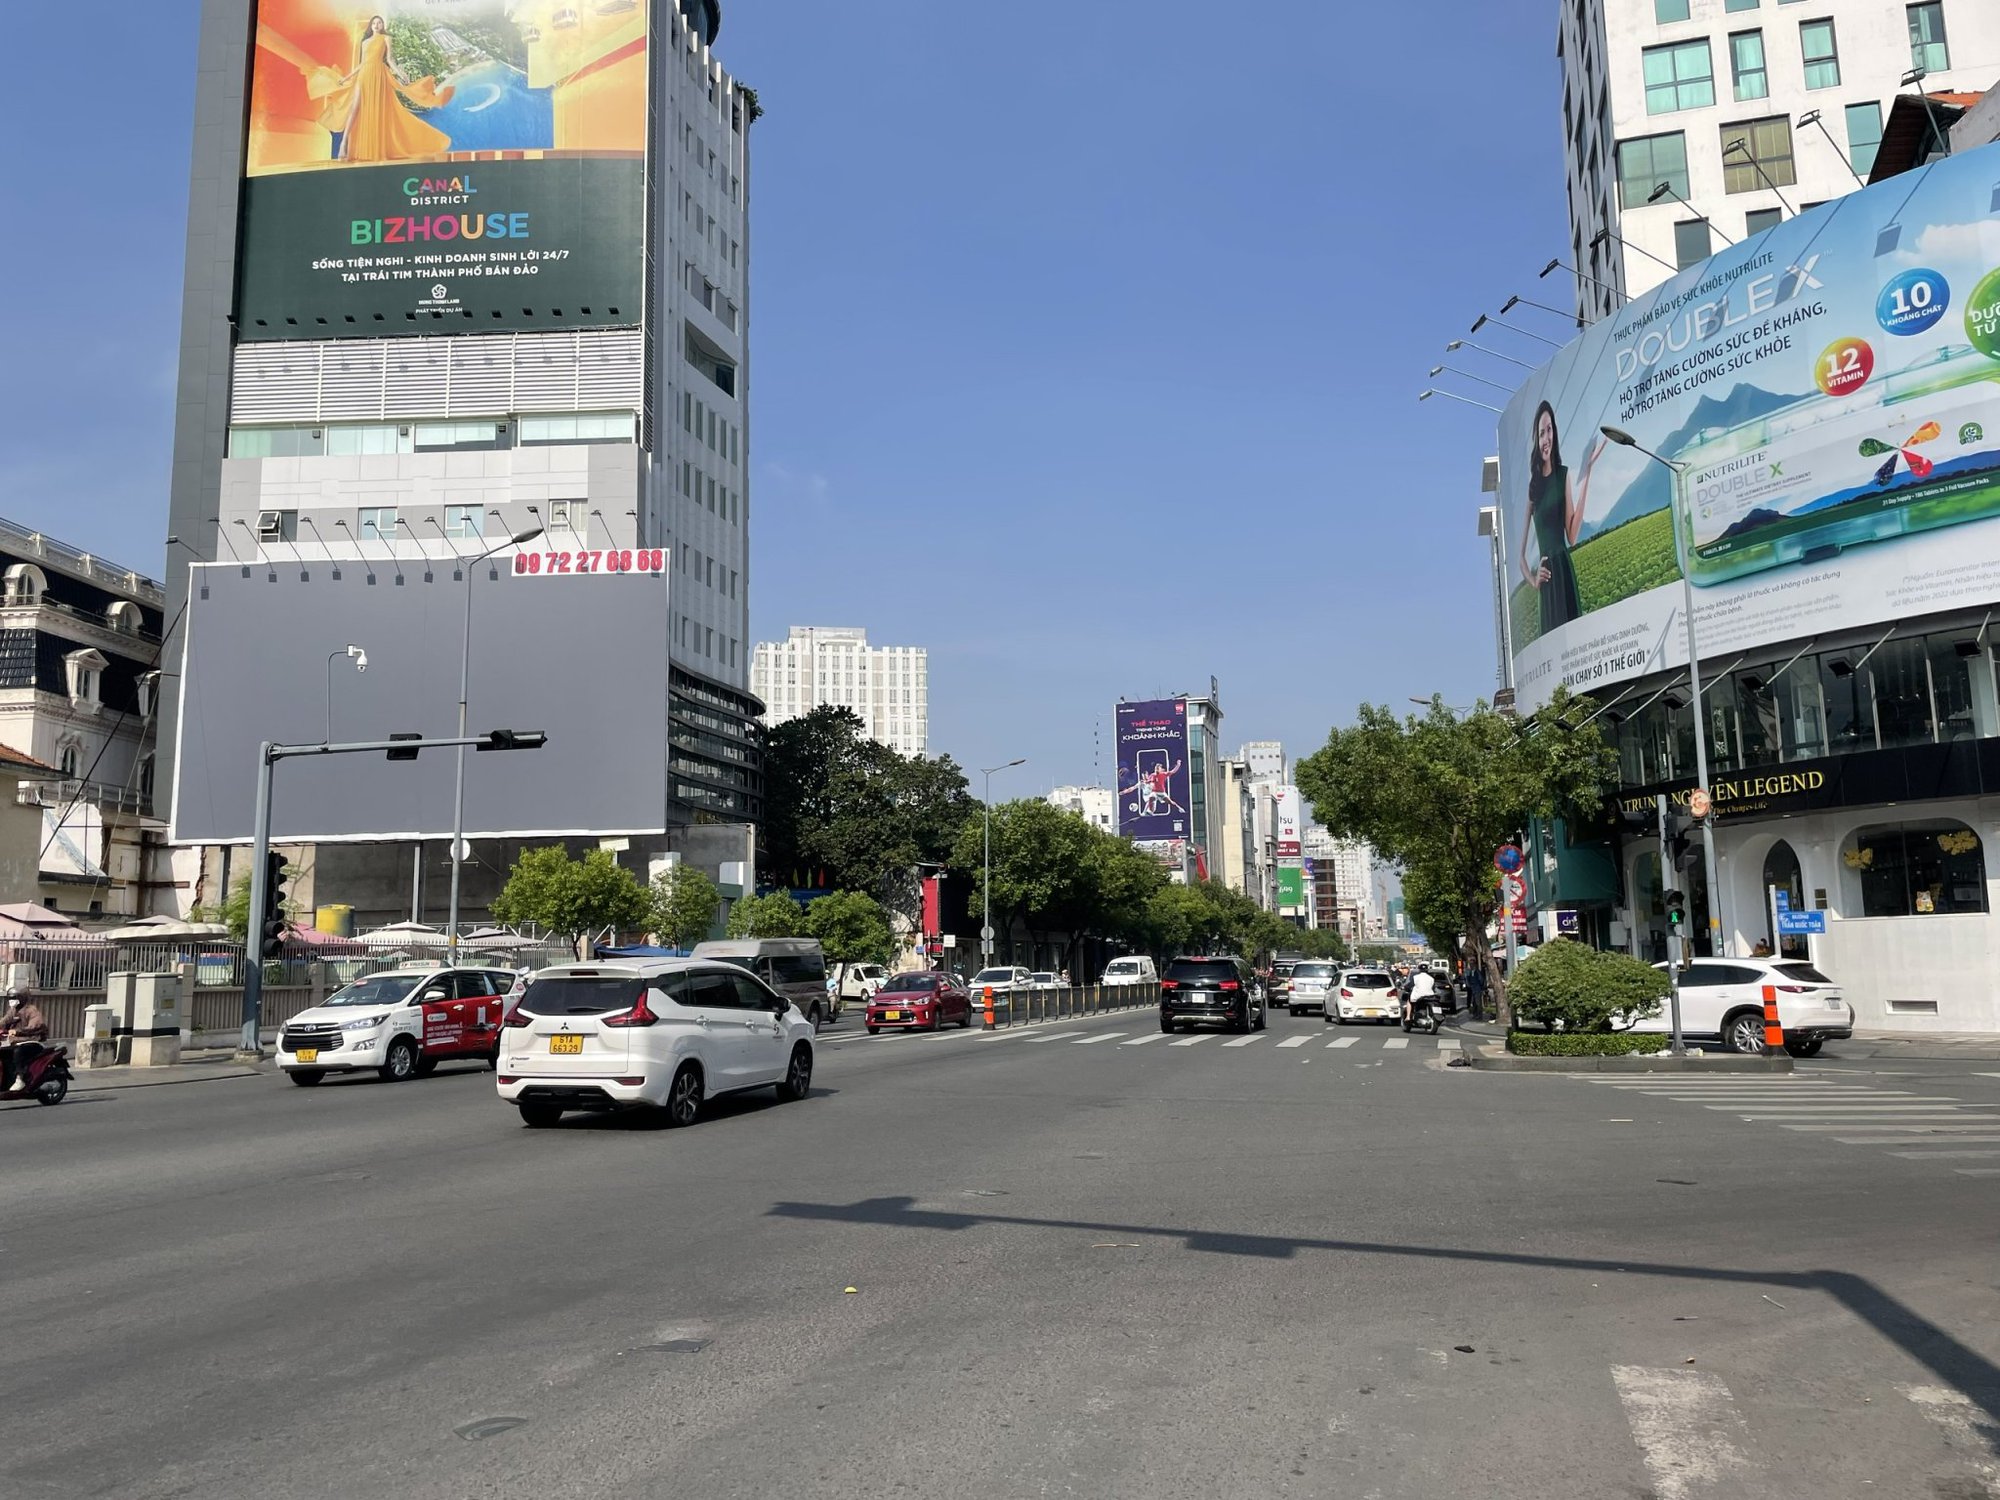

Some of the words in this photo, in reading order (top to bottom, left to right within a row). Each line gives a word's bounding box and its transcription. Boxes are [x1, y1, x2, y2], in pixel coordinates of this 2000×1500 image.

[403, 175, 477, 196] CANAL
[411, 195, 469, 206] DISTRICT
[351, 213, 529, 245] BIZHOUSE
[312, 257, 344, 270] SỐNG
[347, 257, 373, 269] TIỆN
[376, 257, 404, 267] NGHI
[414, 254, 442, 265] KINH
[445, 253, 487, 263] DOANH
[489, 252, 517, 262] SINH
[520, 249, 540, 261] LỜI
[542, 250, 570, 260] 24/7
[341, 272, 360, 284] TẠI
[363, 269, 390, 281] TRÁI
[392, 270, 412, 280] TIM
[415, 267, 455, 279] THÀNH
[458, 264, 482, 277] PHỐ
[485, 265, 510, 276] BÁN
[513, 263, 539, 275] ĐẢO
[1724, 251, 1775, 282] NUTRILITE
[1890, 281, 1932, 315] 10
[1615, 273, 1777, 384] DOUBLE
[1784, 253, 1825, 299] X
[1887, 311, 1921, 327] KHOÁNG
[1921, 303, 1943, 317] CHẤT
[1973, 316, 1997, 337] TỪ
[1619, 386, 1633, 405] HỖ
[1634, 375, 1653, 397] TRỢ
[1654, 361, 1680, 387] TĂNG
[1681, 343, 1724, 373] CƯỜNG
[1725, 327, 1751, 354] SỨC
[1773, 300, 1828, 333] KHÁNG,
[1825, 347, 1862, 378] 12
[1620, 404, 1634, 424] HỖ
[1634, 394, 1654, 417] TRỢ
[1656, 379, 1682, 406] TĂNG
[1683, 361, 1726, 391] CƯỜNG
[1727, 347, 1752, 373] SỨC
[1755, 334, 1792, 362] KHỎE
[1827, 370, 1864, 388] VITAMIN
[1697, 467, 1766, 504] DOUBLE
[1769, 461, 1784, 479] X
[1704, 452, 1767, 482] NUTRILITE
[515, 552, 541, 574] 09
[545, 552, 571, 573] 72
[576, 550, 602, 573] 27
[637, 549, 663, 571] 68
[1575, 666, 1593, 686] CHẠY
[1593, 659, 1603, 679] SỐ
[1604, 661, 1609, 676] 1
[1609, 652, 1626, 674] THẾ
[1627, 648, 1646, 668] GIỚI
[1624, 794, 1659, 813] TRUN
[1744, 771, 1824, 798] LEGEND
